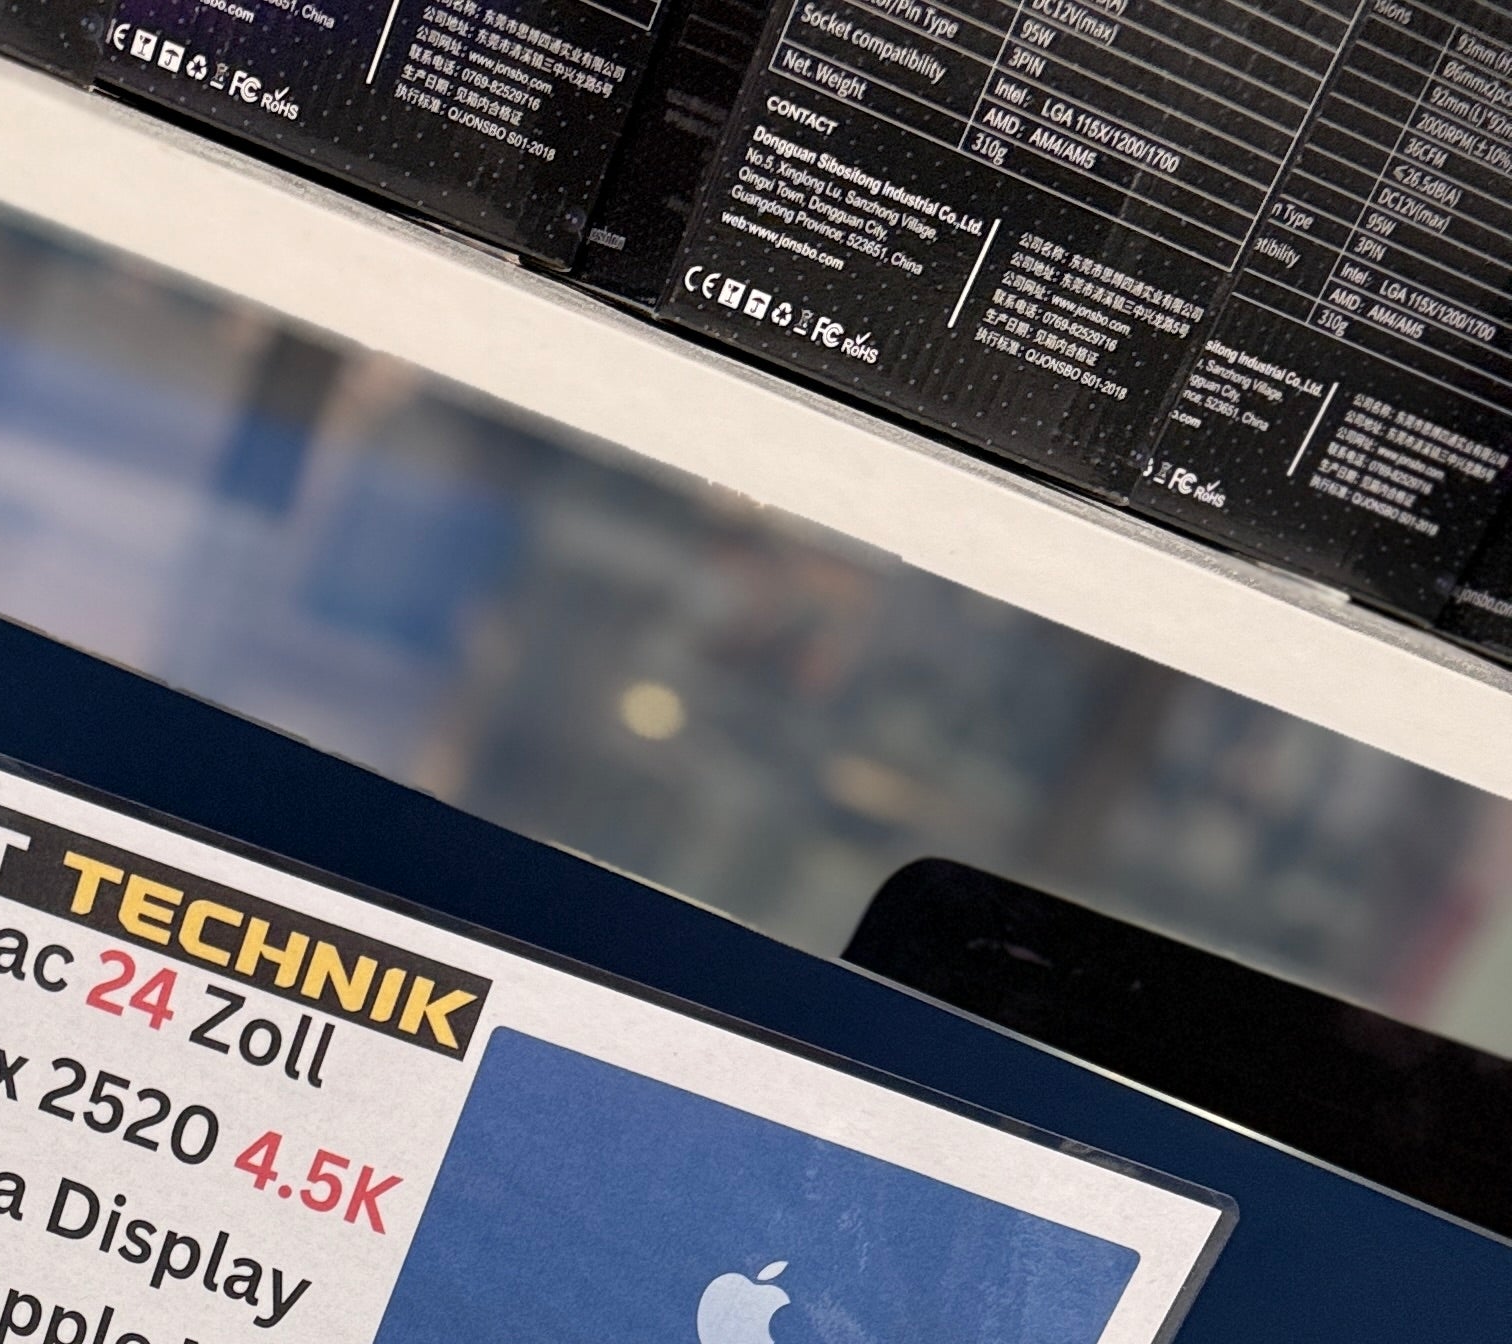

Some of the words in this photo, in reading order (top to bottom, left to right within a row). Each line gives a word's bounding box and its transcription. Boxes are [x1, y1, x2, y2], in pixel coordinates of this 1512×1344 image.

[301, 4, 334, 28] China
[923, 8, 958, 38] Type
[1020, 19, 1056, 48] 95W
[800, 3, 852, 40] Socket
[851, 29, 945, 84] compatibility
[1008, 47, 1045, 77] 3PIN
[815, 62, 866, 100] Weight
[260, 92, 298, 119] RoHS
[766, 96, 838, 134] CONTACT
[971, 132, 1008, 165] 310g
[1028, 127, 1097, 169] AM4/AM5
[1040, 98, 1073, 126] LGA
[1075, 114, 1180, 172] 115X/1200/1700
[752, 125, 816, 164] Dongguan
[816, 152, 882, 195] Sibositong
[881, 180, 939, 216] Industrial
[738, 166, 775, 191] Qingxi
[807, 195, 864, 229] Dongguan
[776, 160, 825, 194] Xinglong
[844, 190, 900, 226] Sanzhong
[731, 184, 795, 223] Guangdong
[890, 251, 922, 275] China
[1379, 279, 1407, 302] LGA
[1366, 304, 1424, 338] AM4/AM5
[840, 337, 878, 363] RoHS
[63, 851, 477, 1048] TECHNIK
[86, 950, 177, 1030] 24
[189, 984, 335, 1088] Zoll
[38, 1057, 219, 1165] 2520
[234, 1131, 403, 1234] 4.5K
[46, 1177, 312, 1328] Display
